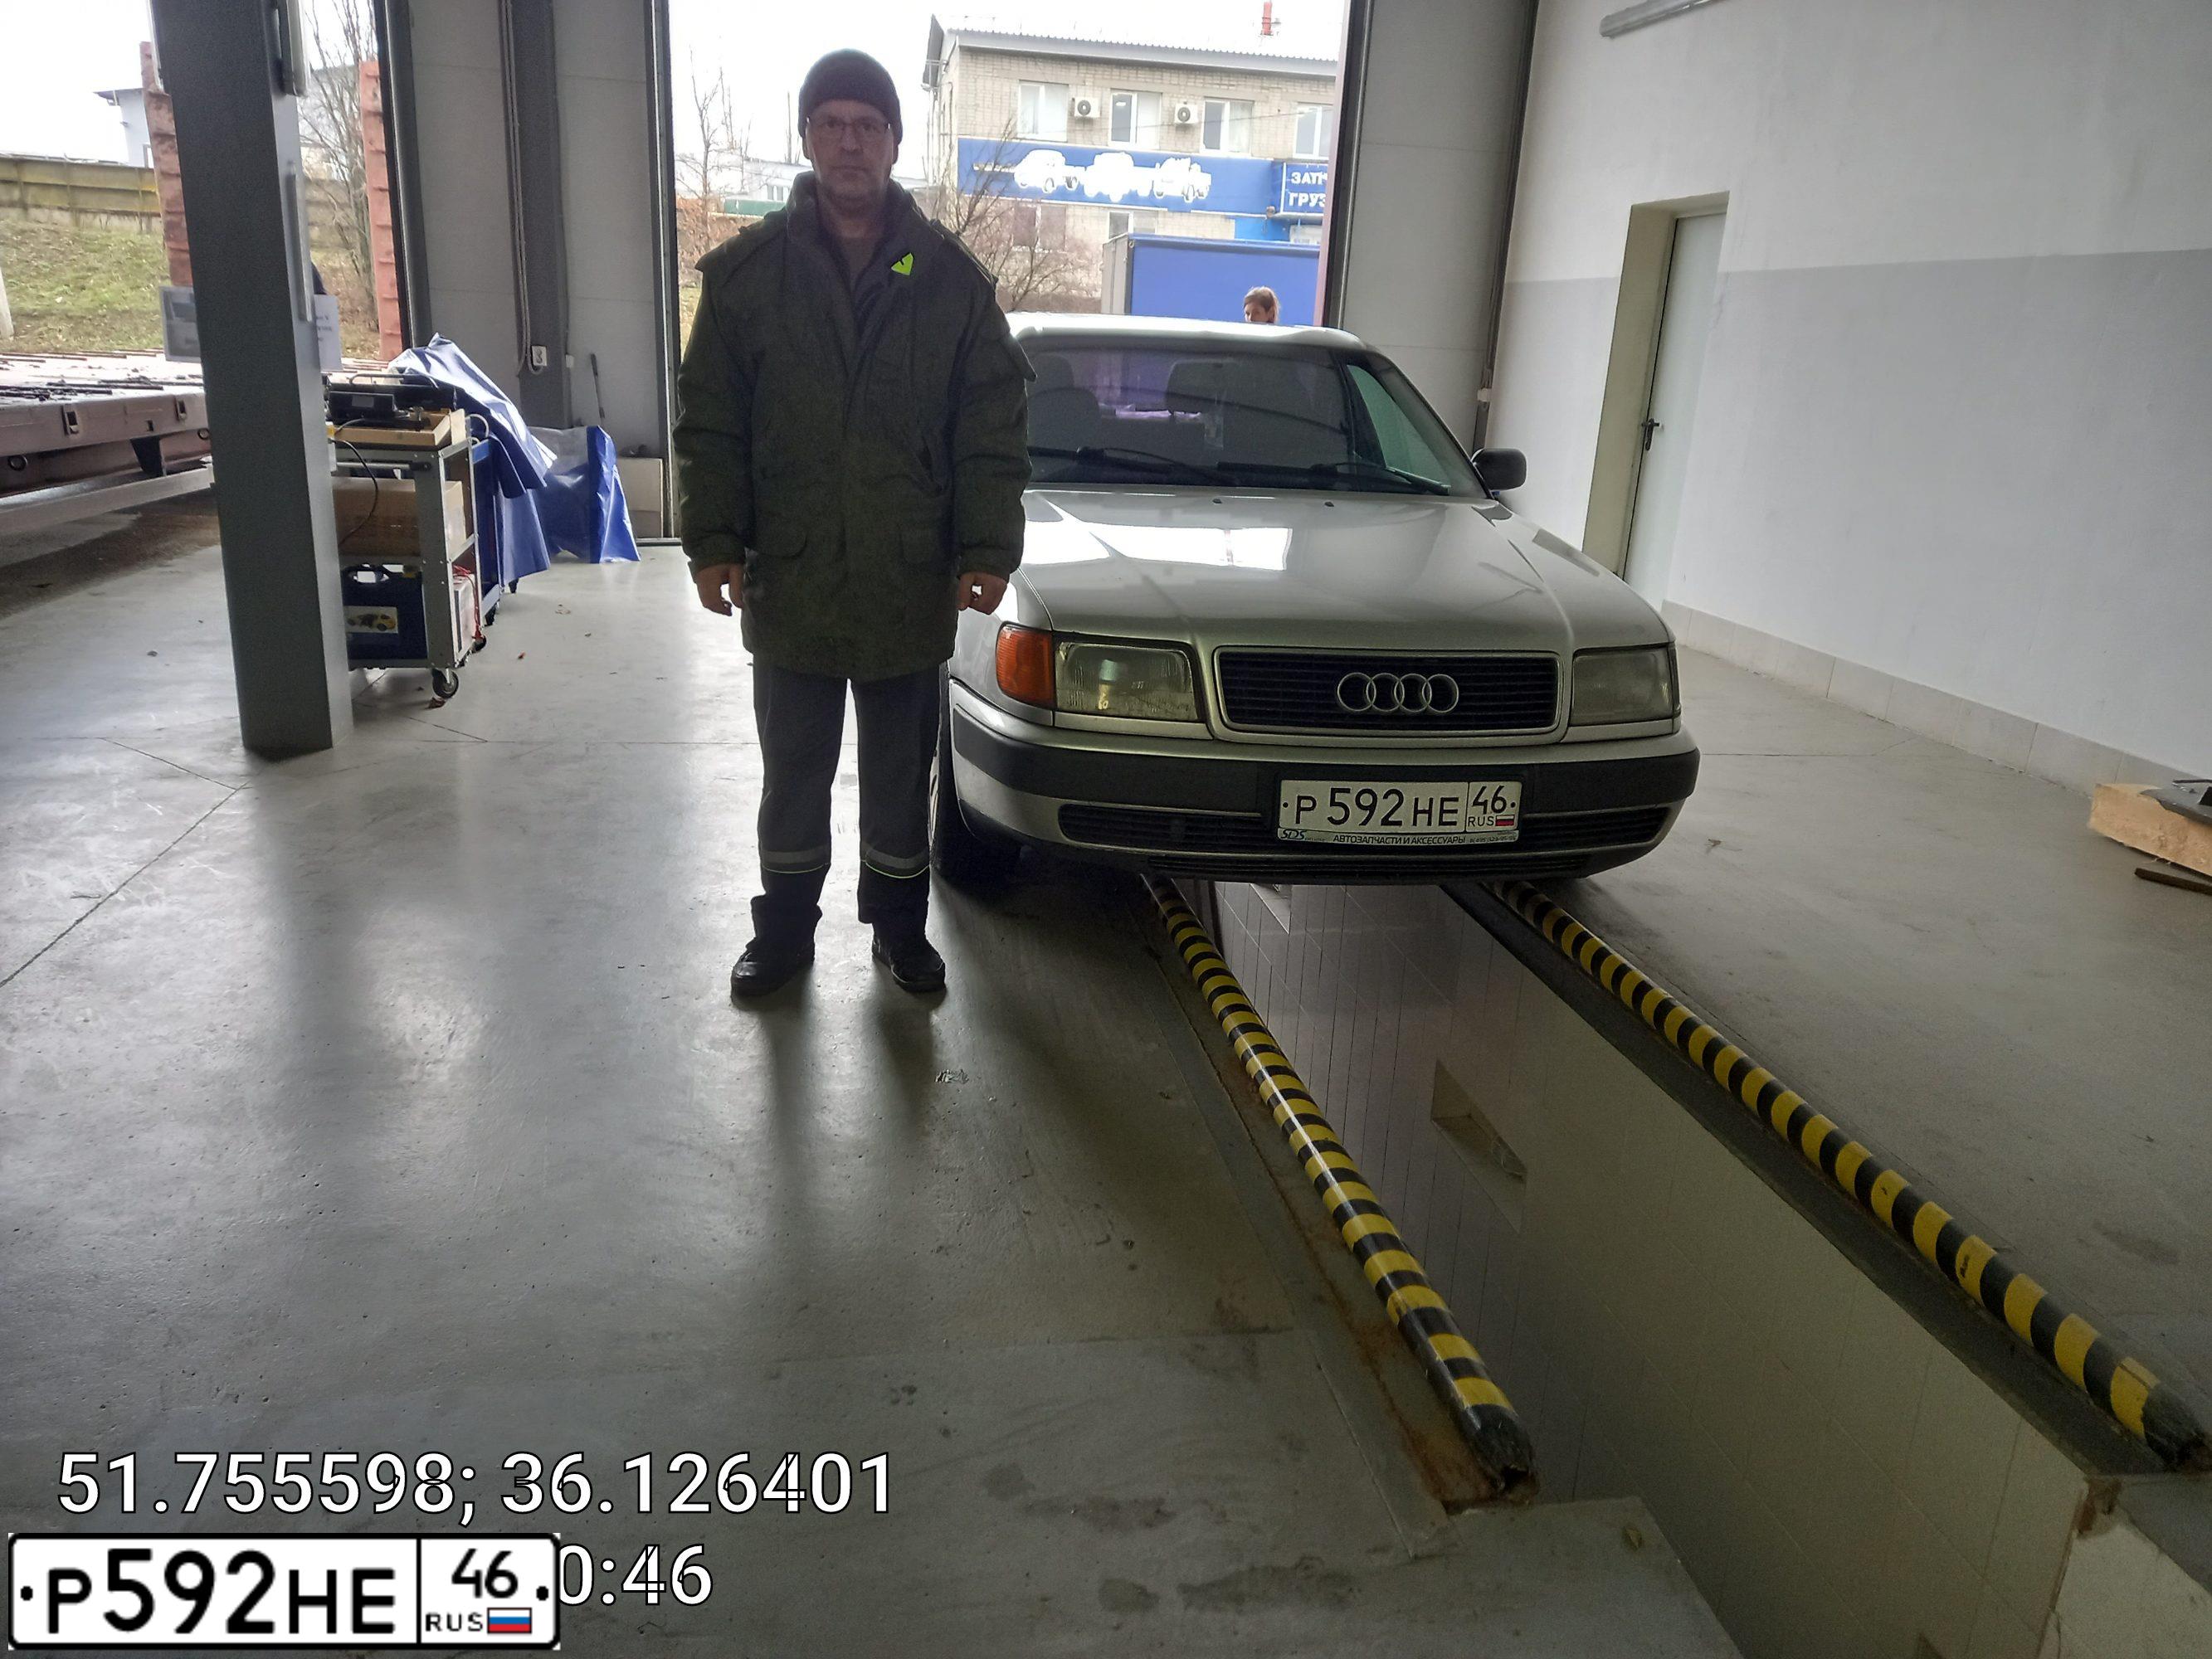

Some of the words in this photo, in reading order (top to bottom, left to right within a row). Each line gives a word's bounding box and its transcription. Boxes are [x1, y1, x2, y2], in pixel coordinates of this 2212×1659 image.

[1471, 785, 1508, 815] 46
[1468, 815, 1494, 827] RUS
[1333, 834, 1402, 845] АВТОЗАПЧАСТИ
[1411, 835, 1466, 845] АКСЕССУАРЫ
